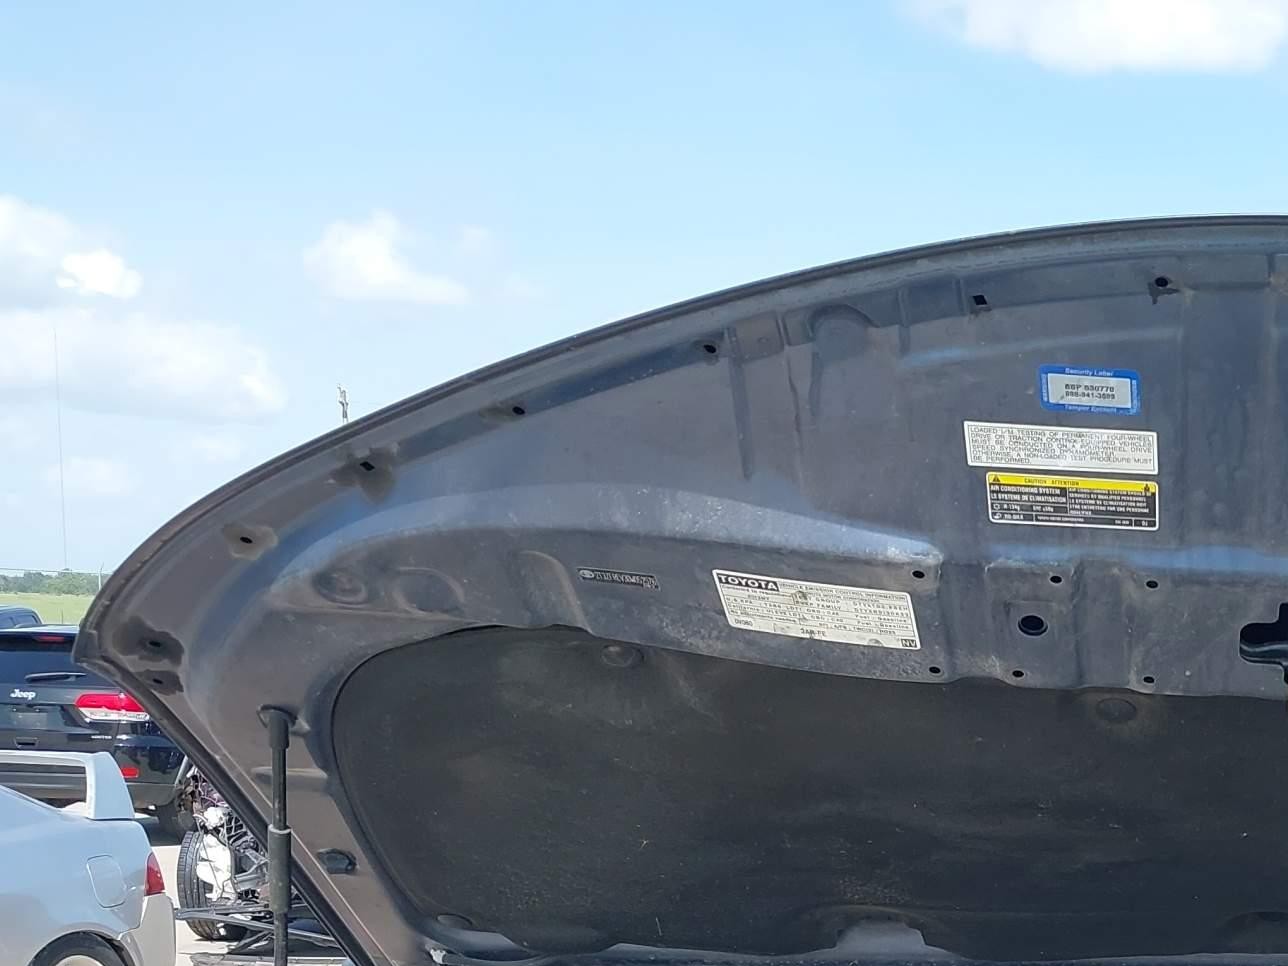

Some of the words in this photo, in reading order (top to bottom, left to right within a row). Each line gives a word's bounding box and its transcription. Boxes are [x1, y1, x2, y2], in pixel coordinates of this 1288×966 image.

[1064, 368, 1092, 376] Security
[718, 575, 778, 591] TOYOTA
[902, 639, 916, 647] NV
[10, 689, 36, 700] Jeep
